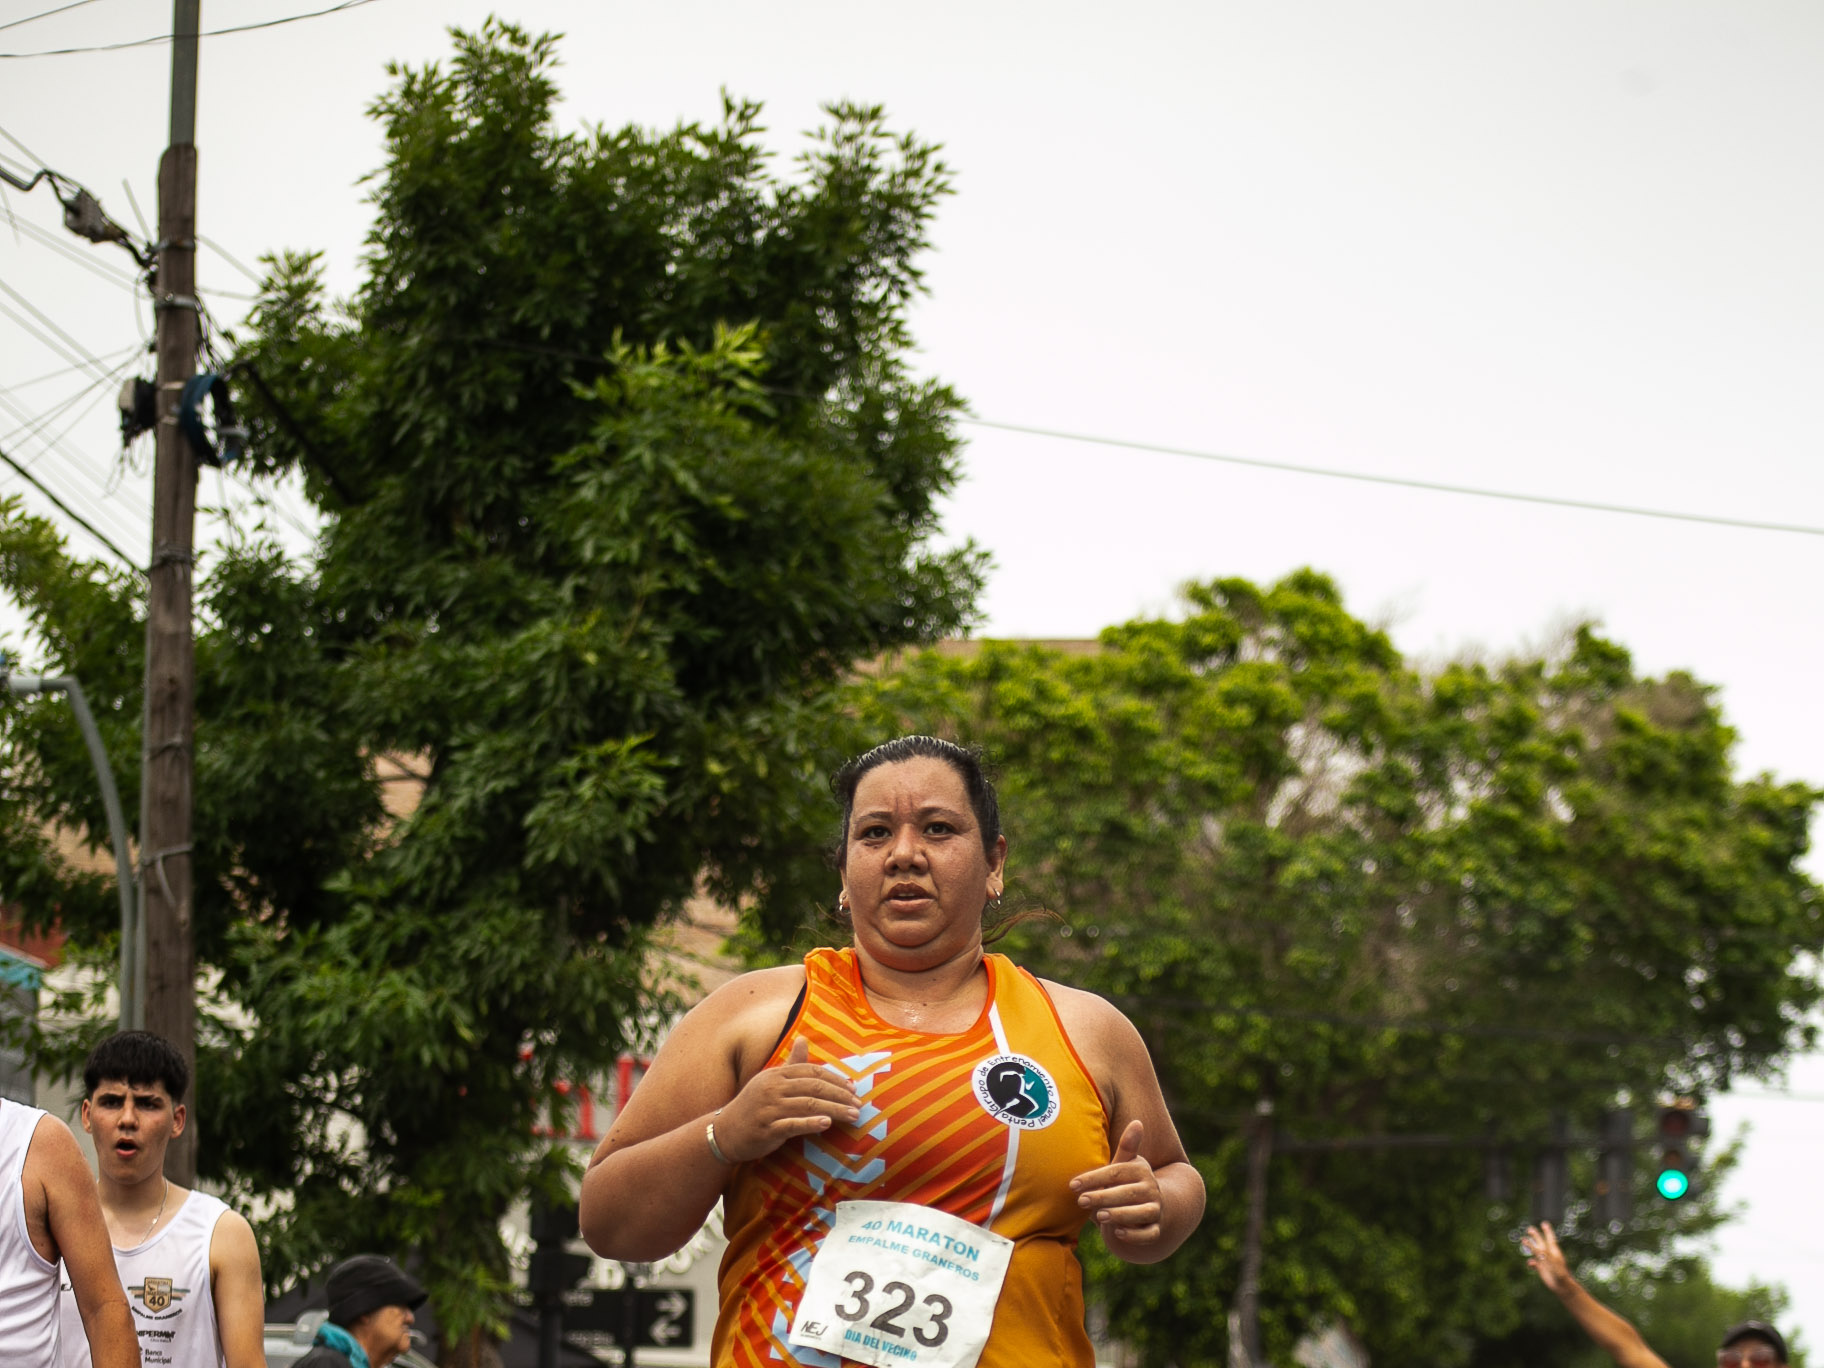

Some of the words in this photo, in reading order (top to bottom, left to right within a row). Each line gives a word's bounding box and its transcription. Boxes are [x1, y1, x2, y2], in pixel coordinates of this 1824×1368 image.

[977, 1066, 989, 1077] de
[987, 1055, 1054, 1097] Entrenamiento
[978, 1079, 1000, 1112] Grupo
[1001, 1112, 1035, 1128] Penta
[1039, 1100, 1057, 1126] Daniel
[860, 1219, 883, 1231] 40
[886, 1219, 981, 1262] MARATON
[848, 1235, 909, 1255] EMPALME
[912, 1248, 981, 1282] GRANEROS
[149, 1295, 165, 1307] 40
[834, 1270, 953, 1348] 323
[844, 1329, 862, 1344] DIA
[863, 1334, 880, 1350] DEL
[881, 1340, 918, 1361] VECINO
